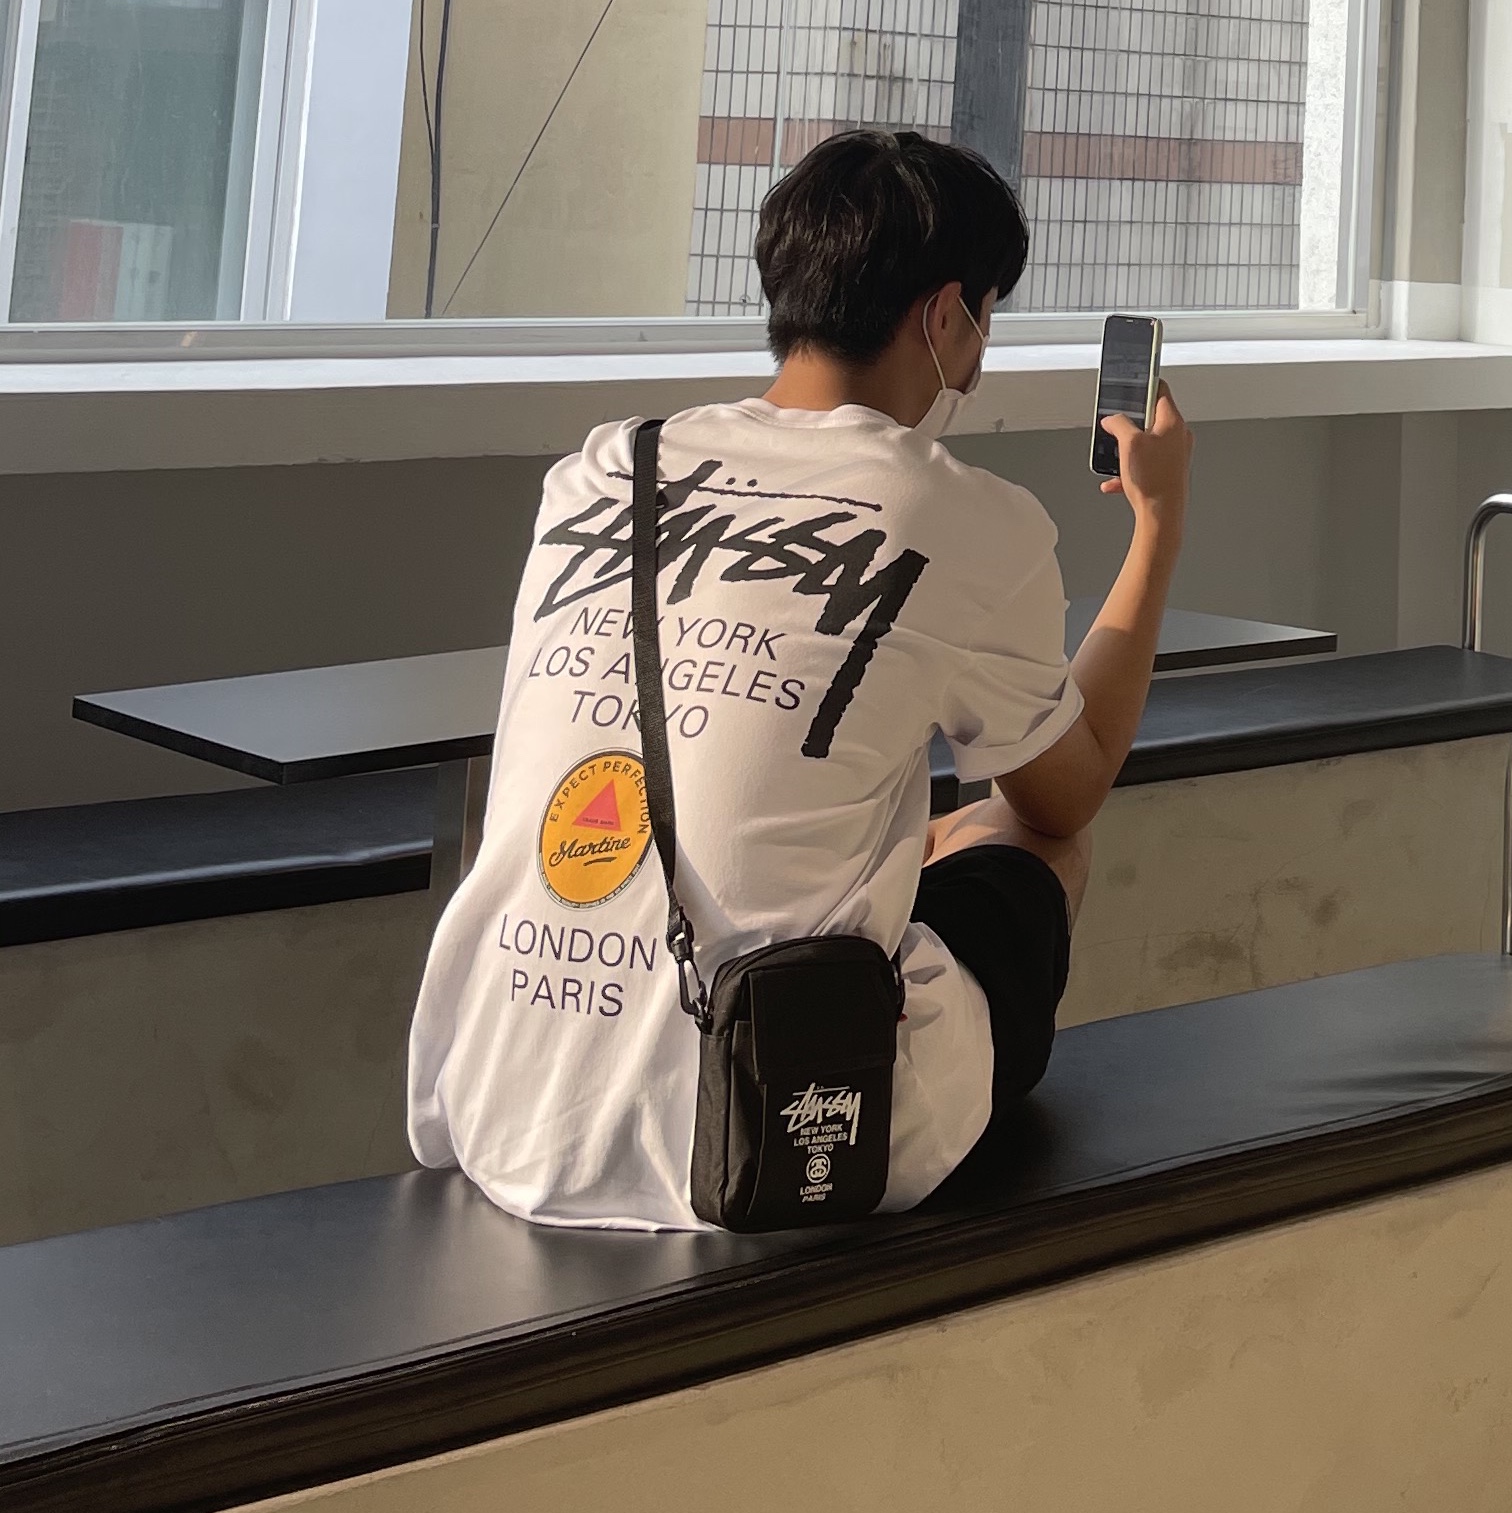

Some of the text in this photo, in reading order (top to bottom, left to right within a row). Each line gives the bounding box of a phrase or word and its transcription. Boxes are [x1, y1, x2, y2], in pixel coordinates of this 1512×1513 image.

[673, 617, 786, 661] YORK
[529, 647, 806, 711] LOS AGELES
[549, 764, 597, 823] EXPECT
[549, 837, 631, 867] Martine
[499, 914, 657, 971] LONDON
[511, 969, 624, 1017] PARIS
[793, 1132, 848, 1147] LOS ANGELES
[800, 1124, 843, 1136] NEW YORK
[807, 1143, 834, 1155] TOKYO
[800, 1182, 833, 1196] LONDON
